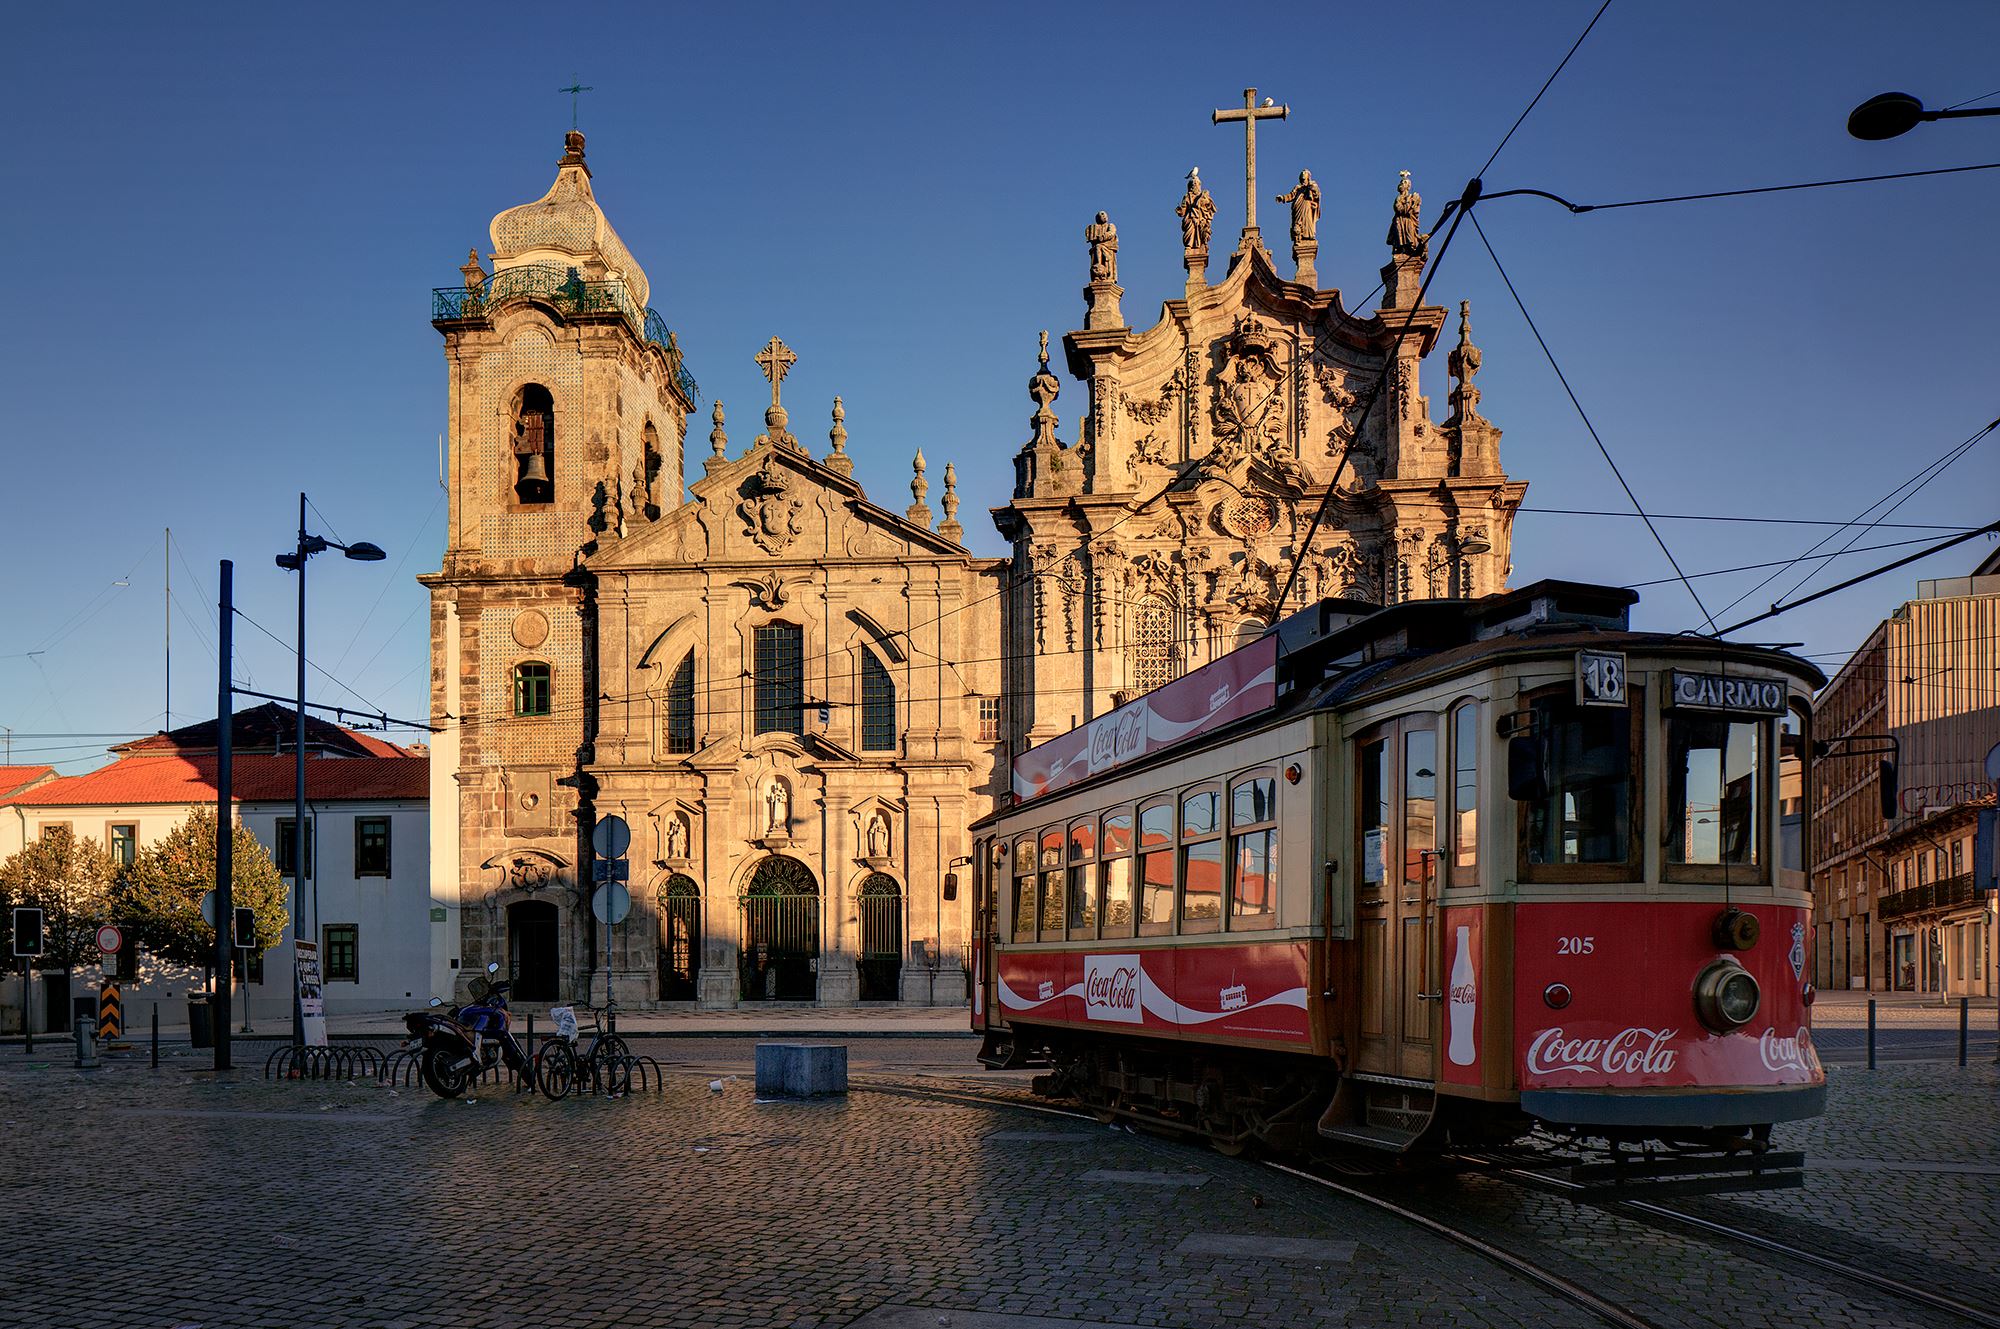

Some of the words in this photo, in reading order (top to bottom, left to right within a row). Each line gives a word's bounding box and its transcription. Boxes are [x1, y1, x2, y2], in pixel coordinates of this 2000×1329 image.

[1587, 659, 1619, 698] 18
[1680, 675, 1782, 709] CARMO
[1557, 937, 1595, 955] 205
[1087, 967, 1138, 1009] Coca-Cola
[1527, 1027, 1679, 1075] Coca-Cola
